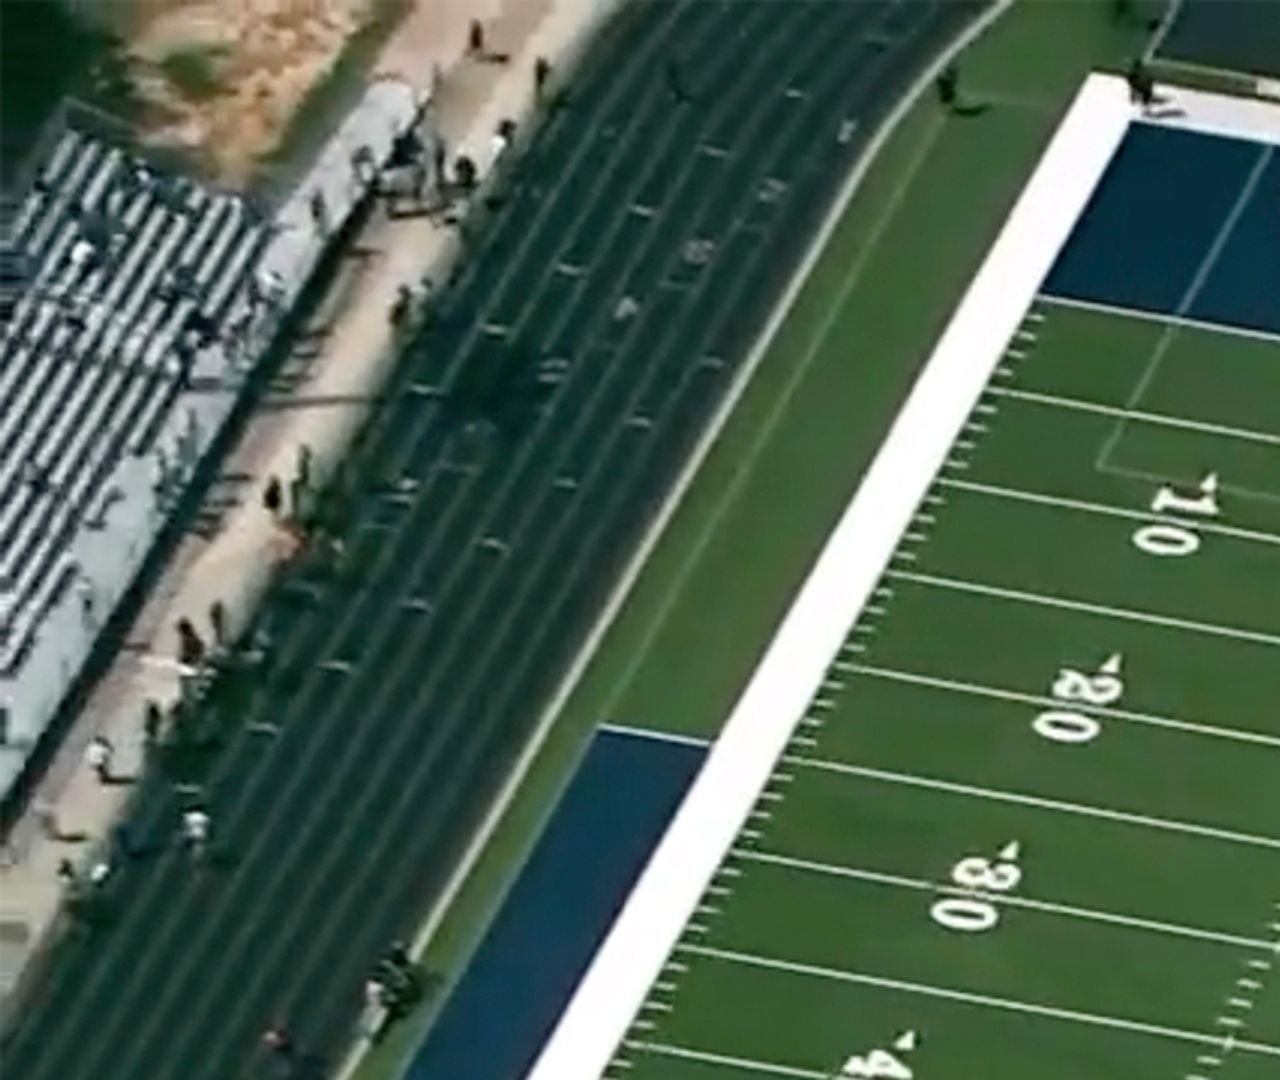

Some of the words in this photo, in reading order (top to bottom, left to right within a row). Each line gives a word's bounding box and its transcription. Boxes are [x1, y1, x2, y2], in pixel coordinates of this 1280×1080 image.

[1132, 487, 1219, 555] 10
[1032, 667, 1122, 742] 20
[931, 857, 1020, 930] 30
